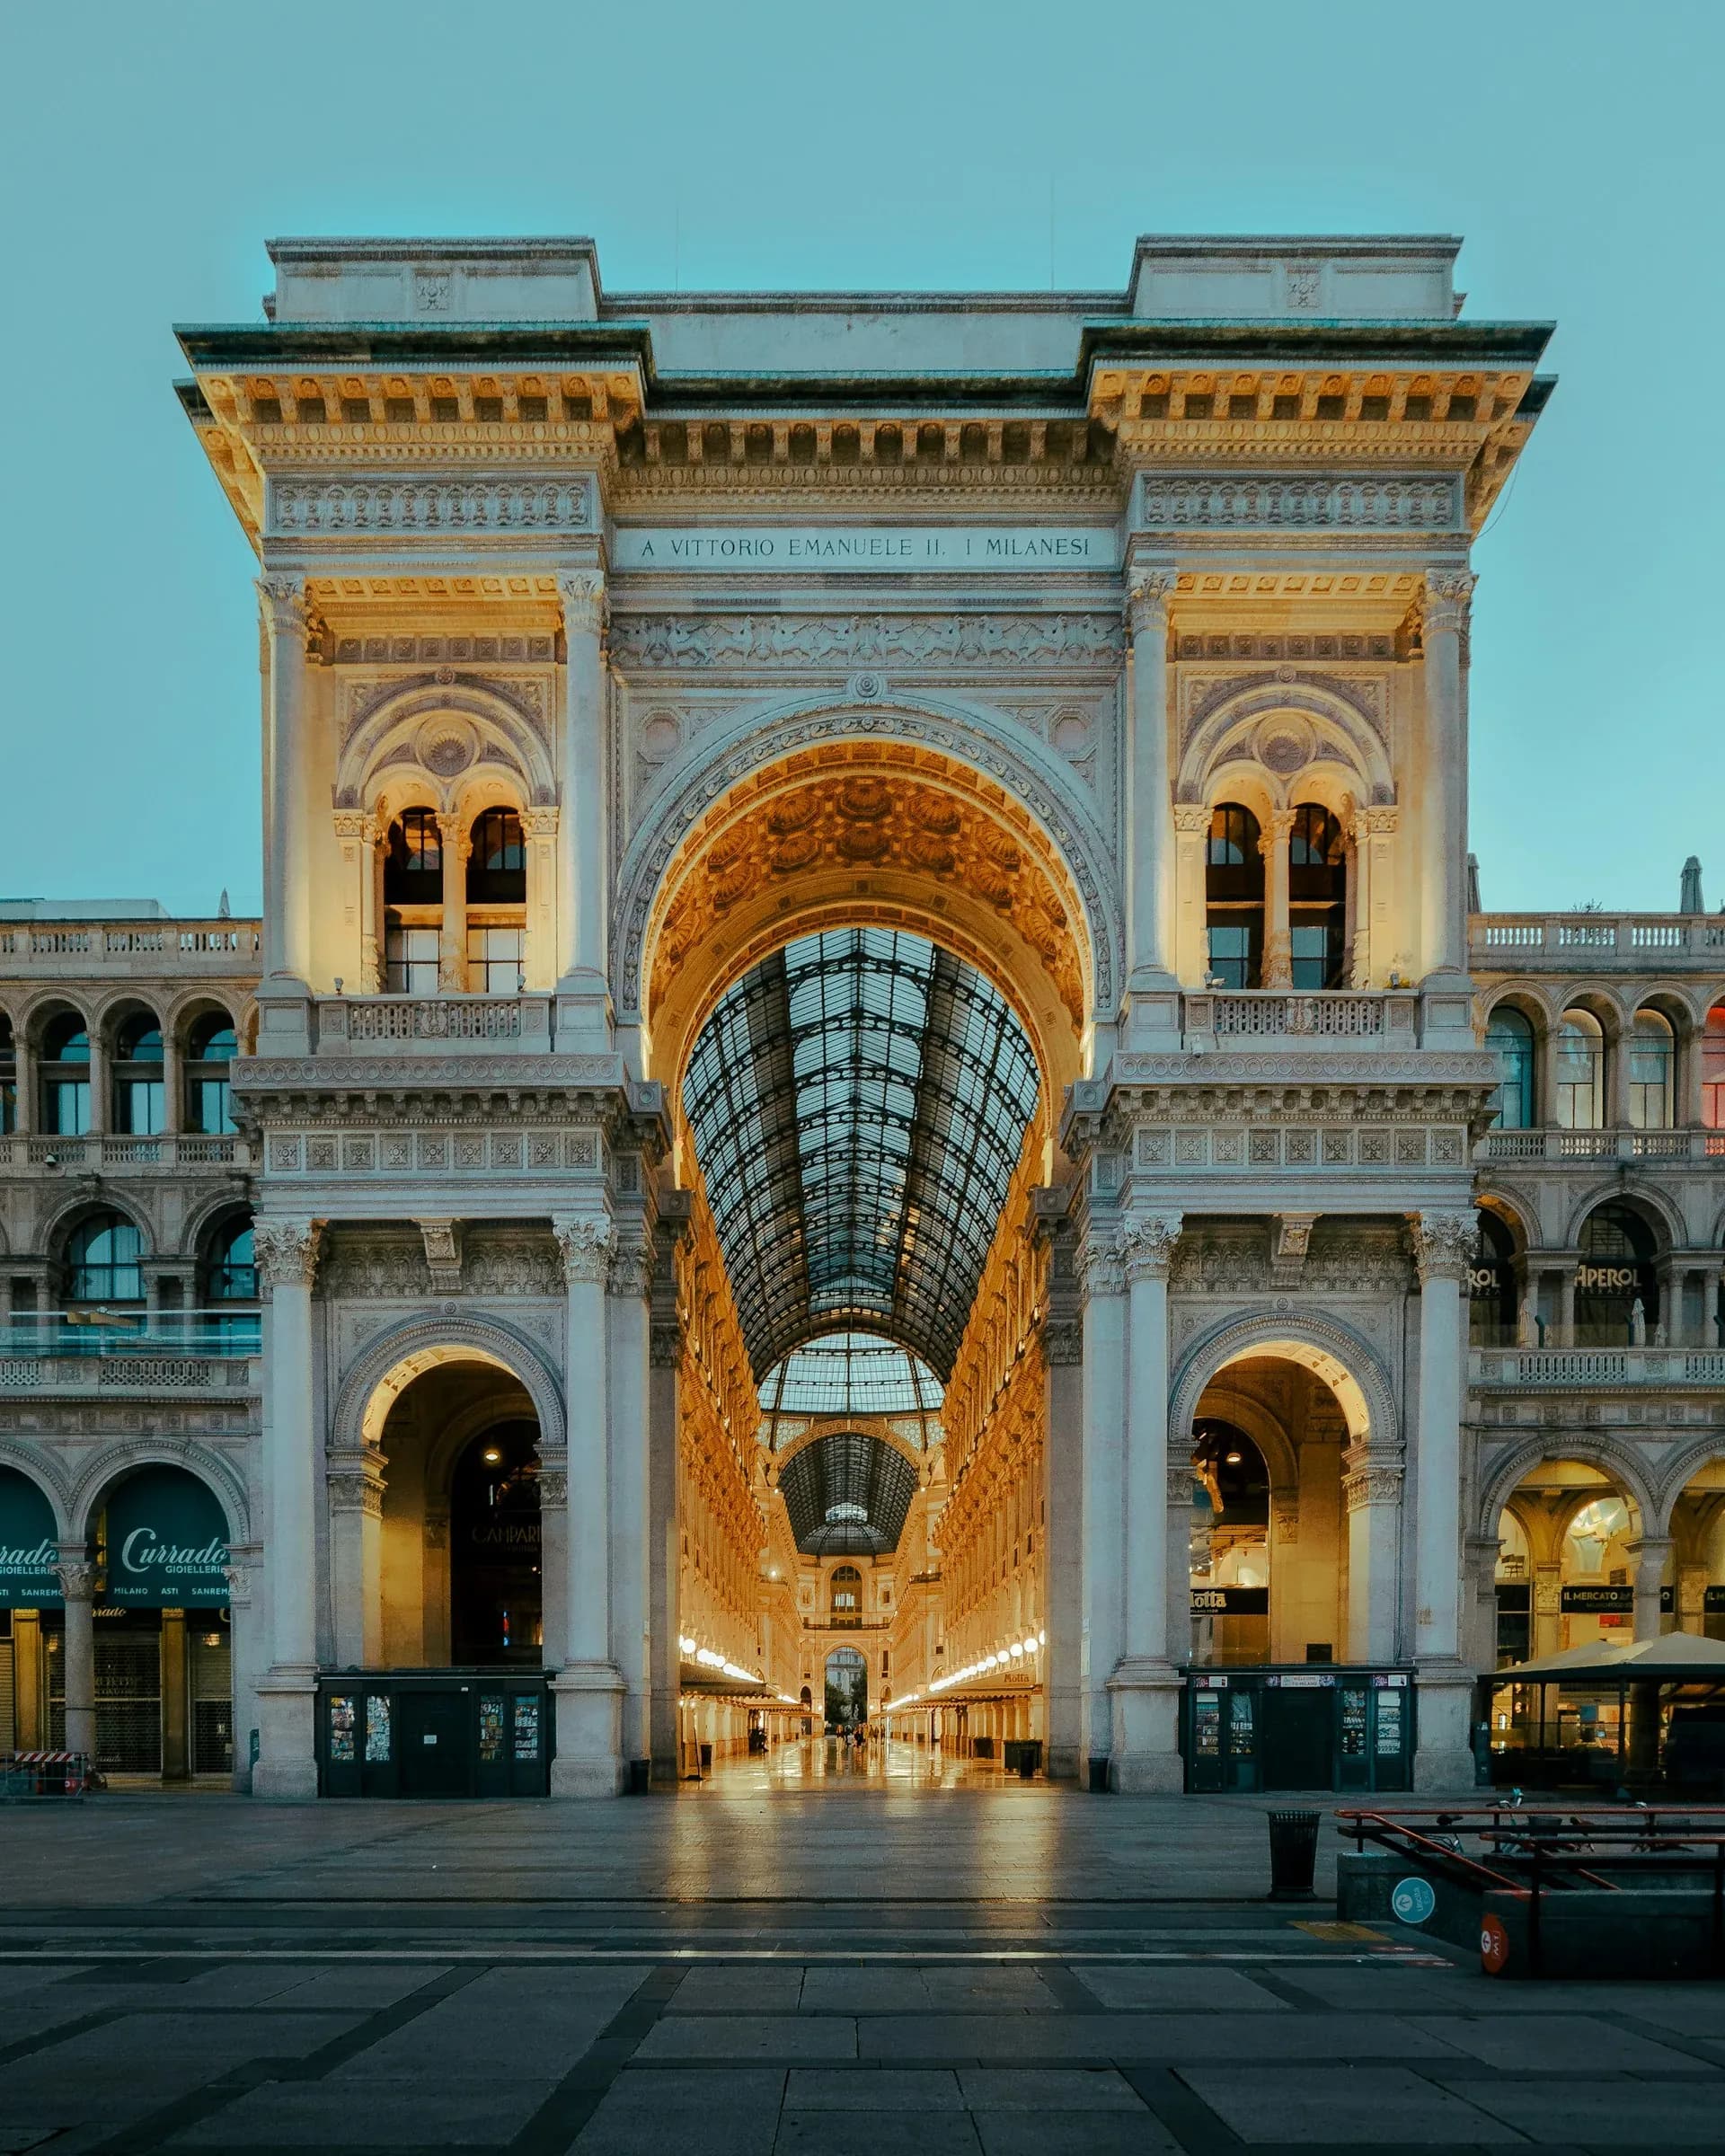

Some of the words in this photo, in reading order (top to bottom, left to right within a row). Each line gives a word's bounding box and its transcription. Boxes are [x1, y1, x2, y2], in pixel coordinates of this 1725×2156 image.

[641, 539, 654, 556] A
[670, 539, 774, 556] VITTORIO
[789, 539, 913, 556] EMANUELE
[966, 539, 971, 555] I
[986, 539, 1089, 556] MILANESI
[1573, 1265, 1642, 1287] APEROL
[471, 1525, 541, 1543] CAMPARI
[122, 1527, 228, 1573] Currado
[114, 1587, 148, 1595] MILANO
[161, 1587, 179, 1595] ASTI
[191, 1587, 229, 1595] SANREM
[1563, 1592, 1572, 1601] IL
[1573, 1592, 1618, 1601] MERCATO
[1004, 1674, 1030, 1683] Motta
